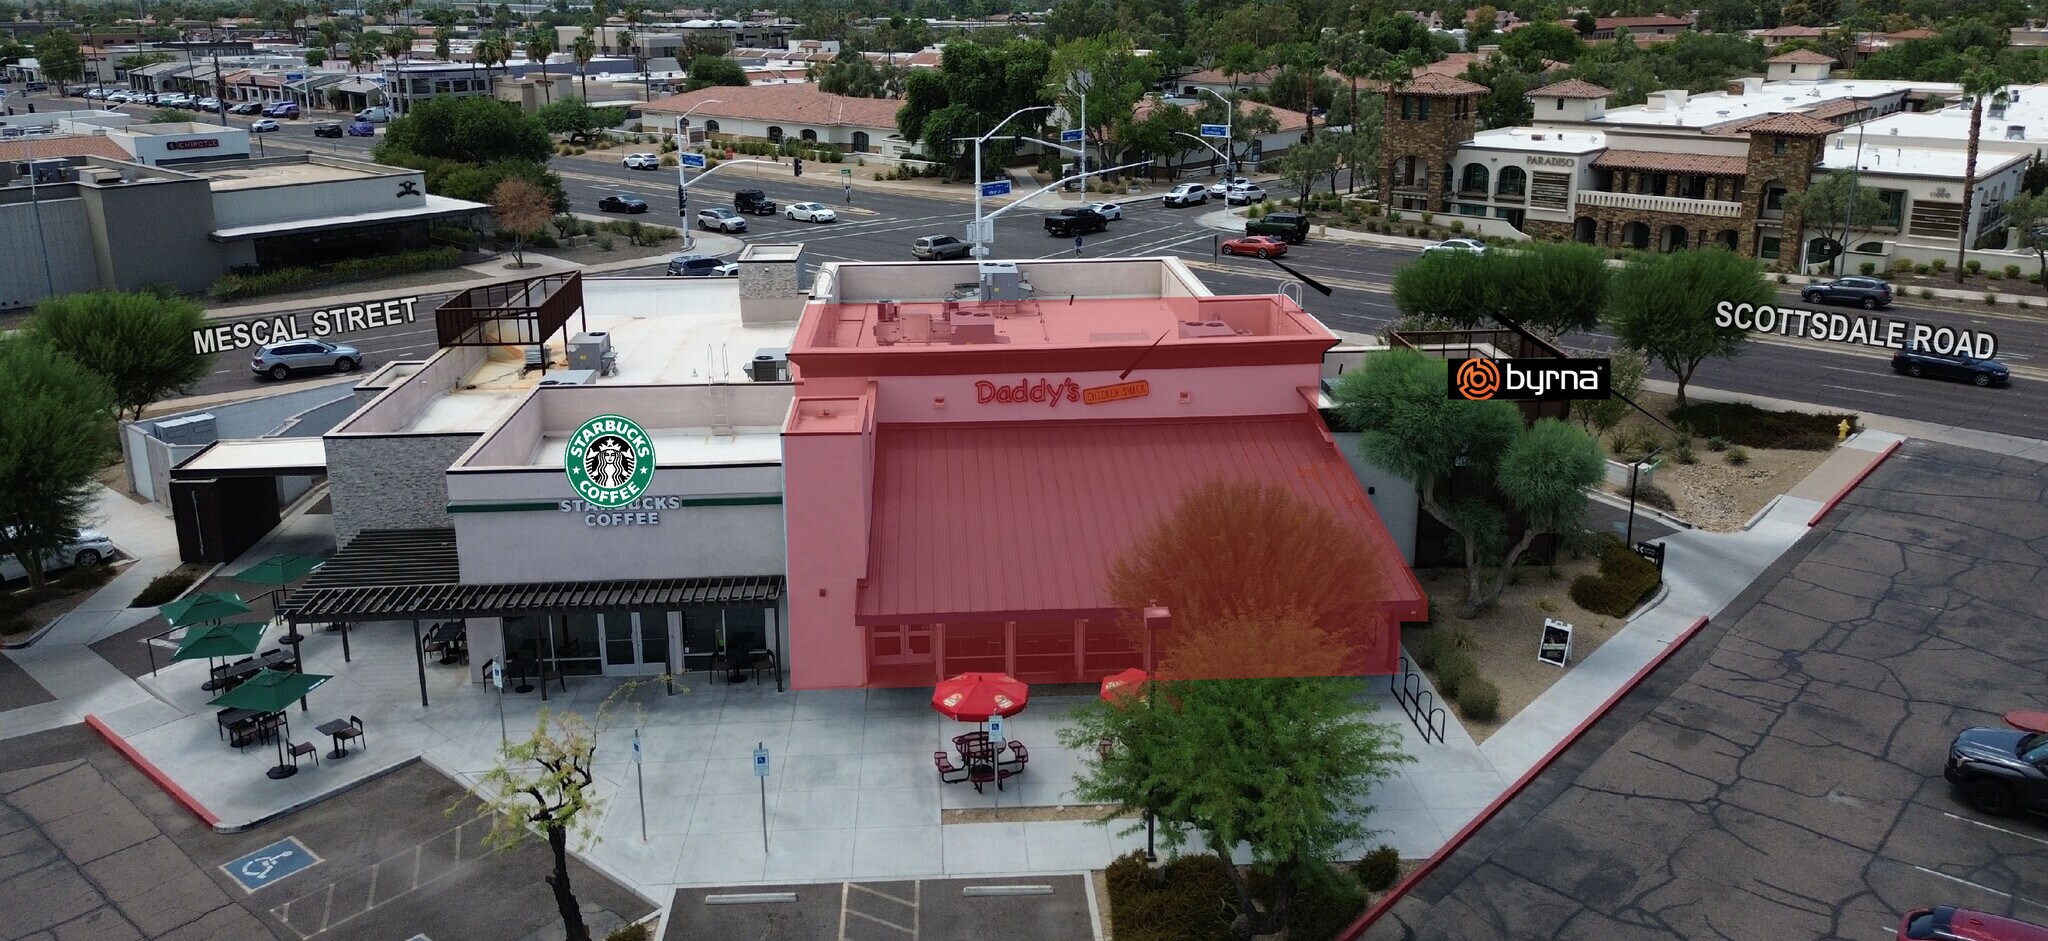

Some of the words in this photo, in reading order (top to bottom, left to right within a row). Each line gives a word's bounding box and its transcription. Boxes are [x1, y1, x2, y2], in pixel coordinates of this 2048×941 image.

[1526, 155, 1575, 167] PARADISO
[975, 377, 1081, 408] Daddy's
[1087, 388, 1120, 402] CHICKEN
[1122, 383, 1147, 396] SHACK
[560, 496, 681, 513] STAUCKS
[584, 512, 660, 527] COFFEE
